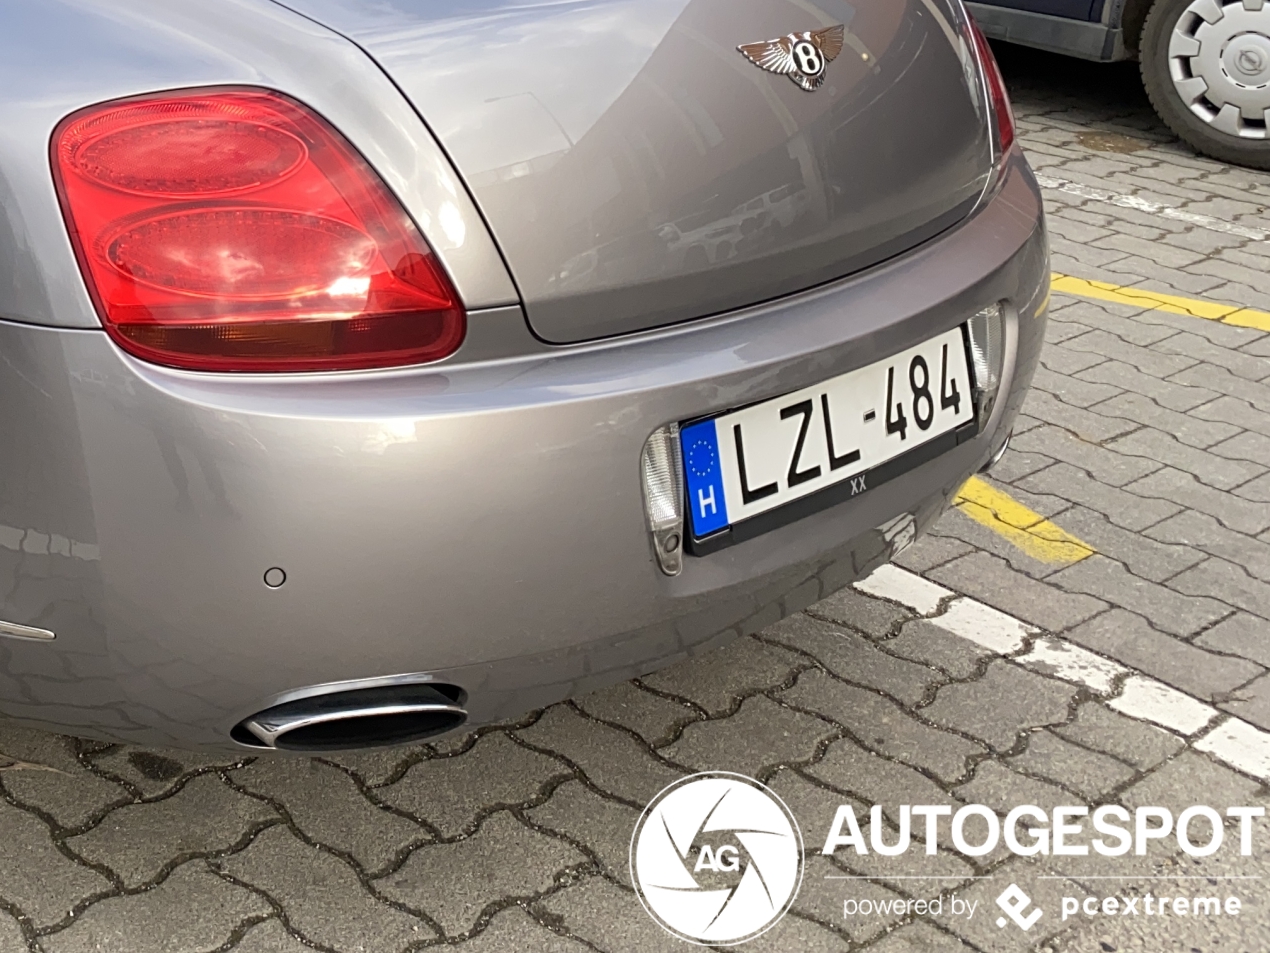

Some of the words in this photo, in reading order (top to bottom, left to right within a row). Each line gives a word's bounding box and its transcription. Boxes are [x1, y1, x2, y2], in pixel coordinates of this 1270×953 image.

[795, 42, 821, 75] B
[733, 343, 961, 506] LZL-484
[697, 484, 718, 519] H
[849, 475, 867, 496] XX
